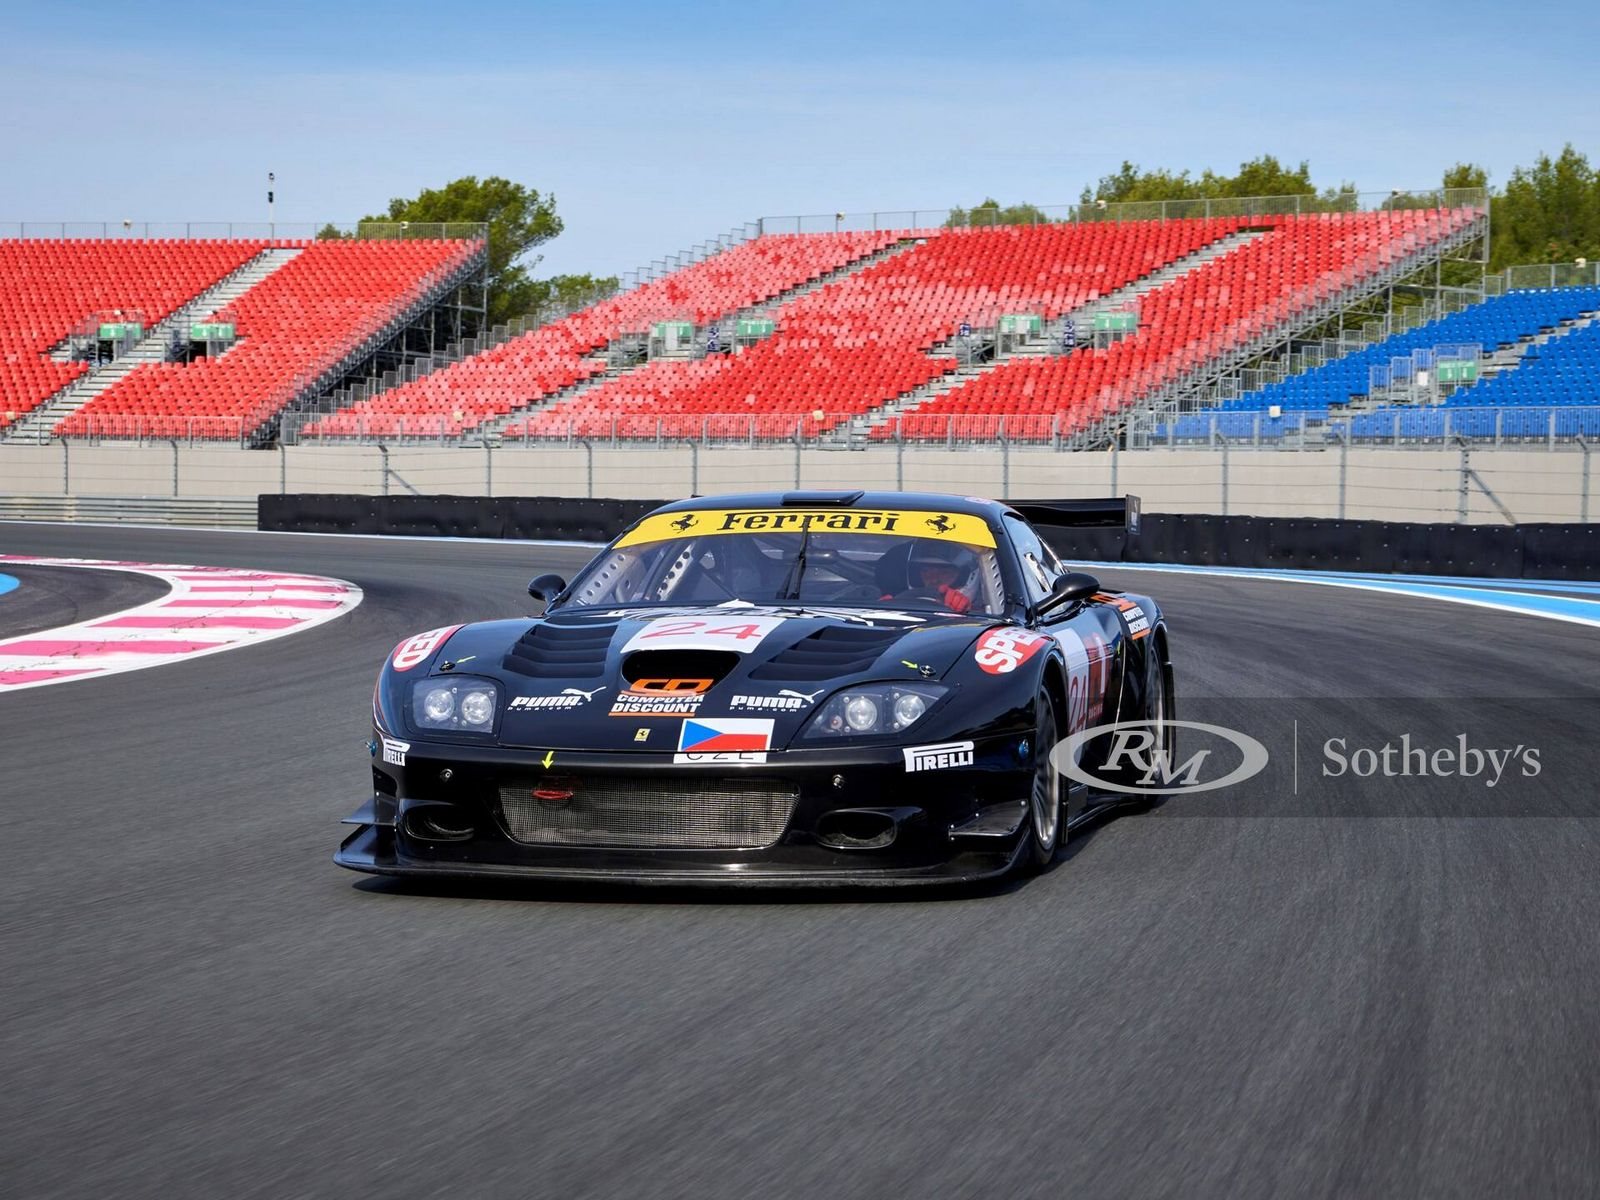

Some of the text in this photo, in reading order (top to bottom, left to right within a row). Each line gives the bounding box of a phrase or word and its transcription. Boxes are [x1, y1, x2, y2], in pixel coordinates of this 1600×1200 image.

[716, 511, 900, 532] Ferrari
[640, 622, 762, 640] 24
[630, 678, 714, 694] CD
[510, 695, 582, 707] PUMA
[616, 693, 705, 704] COMPUTER
[730, 695, 803, 708] PUMA
[611, 702, 701, 713] DISCOUNT
[902, 740, 974, 773] PIRELLI
